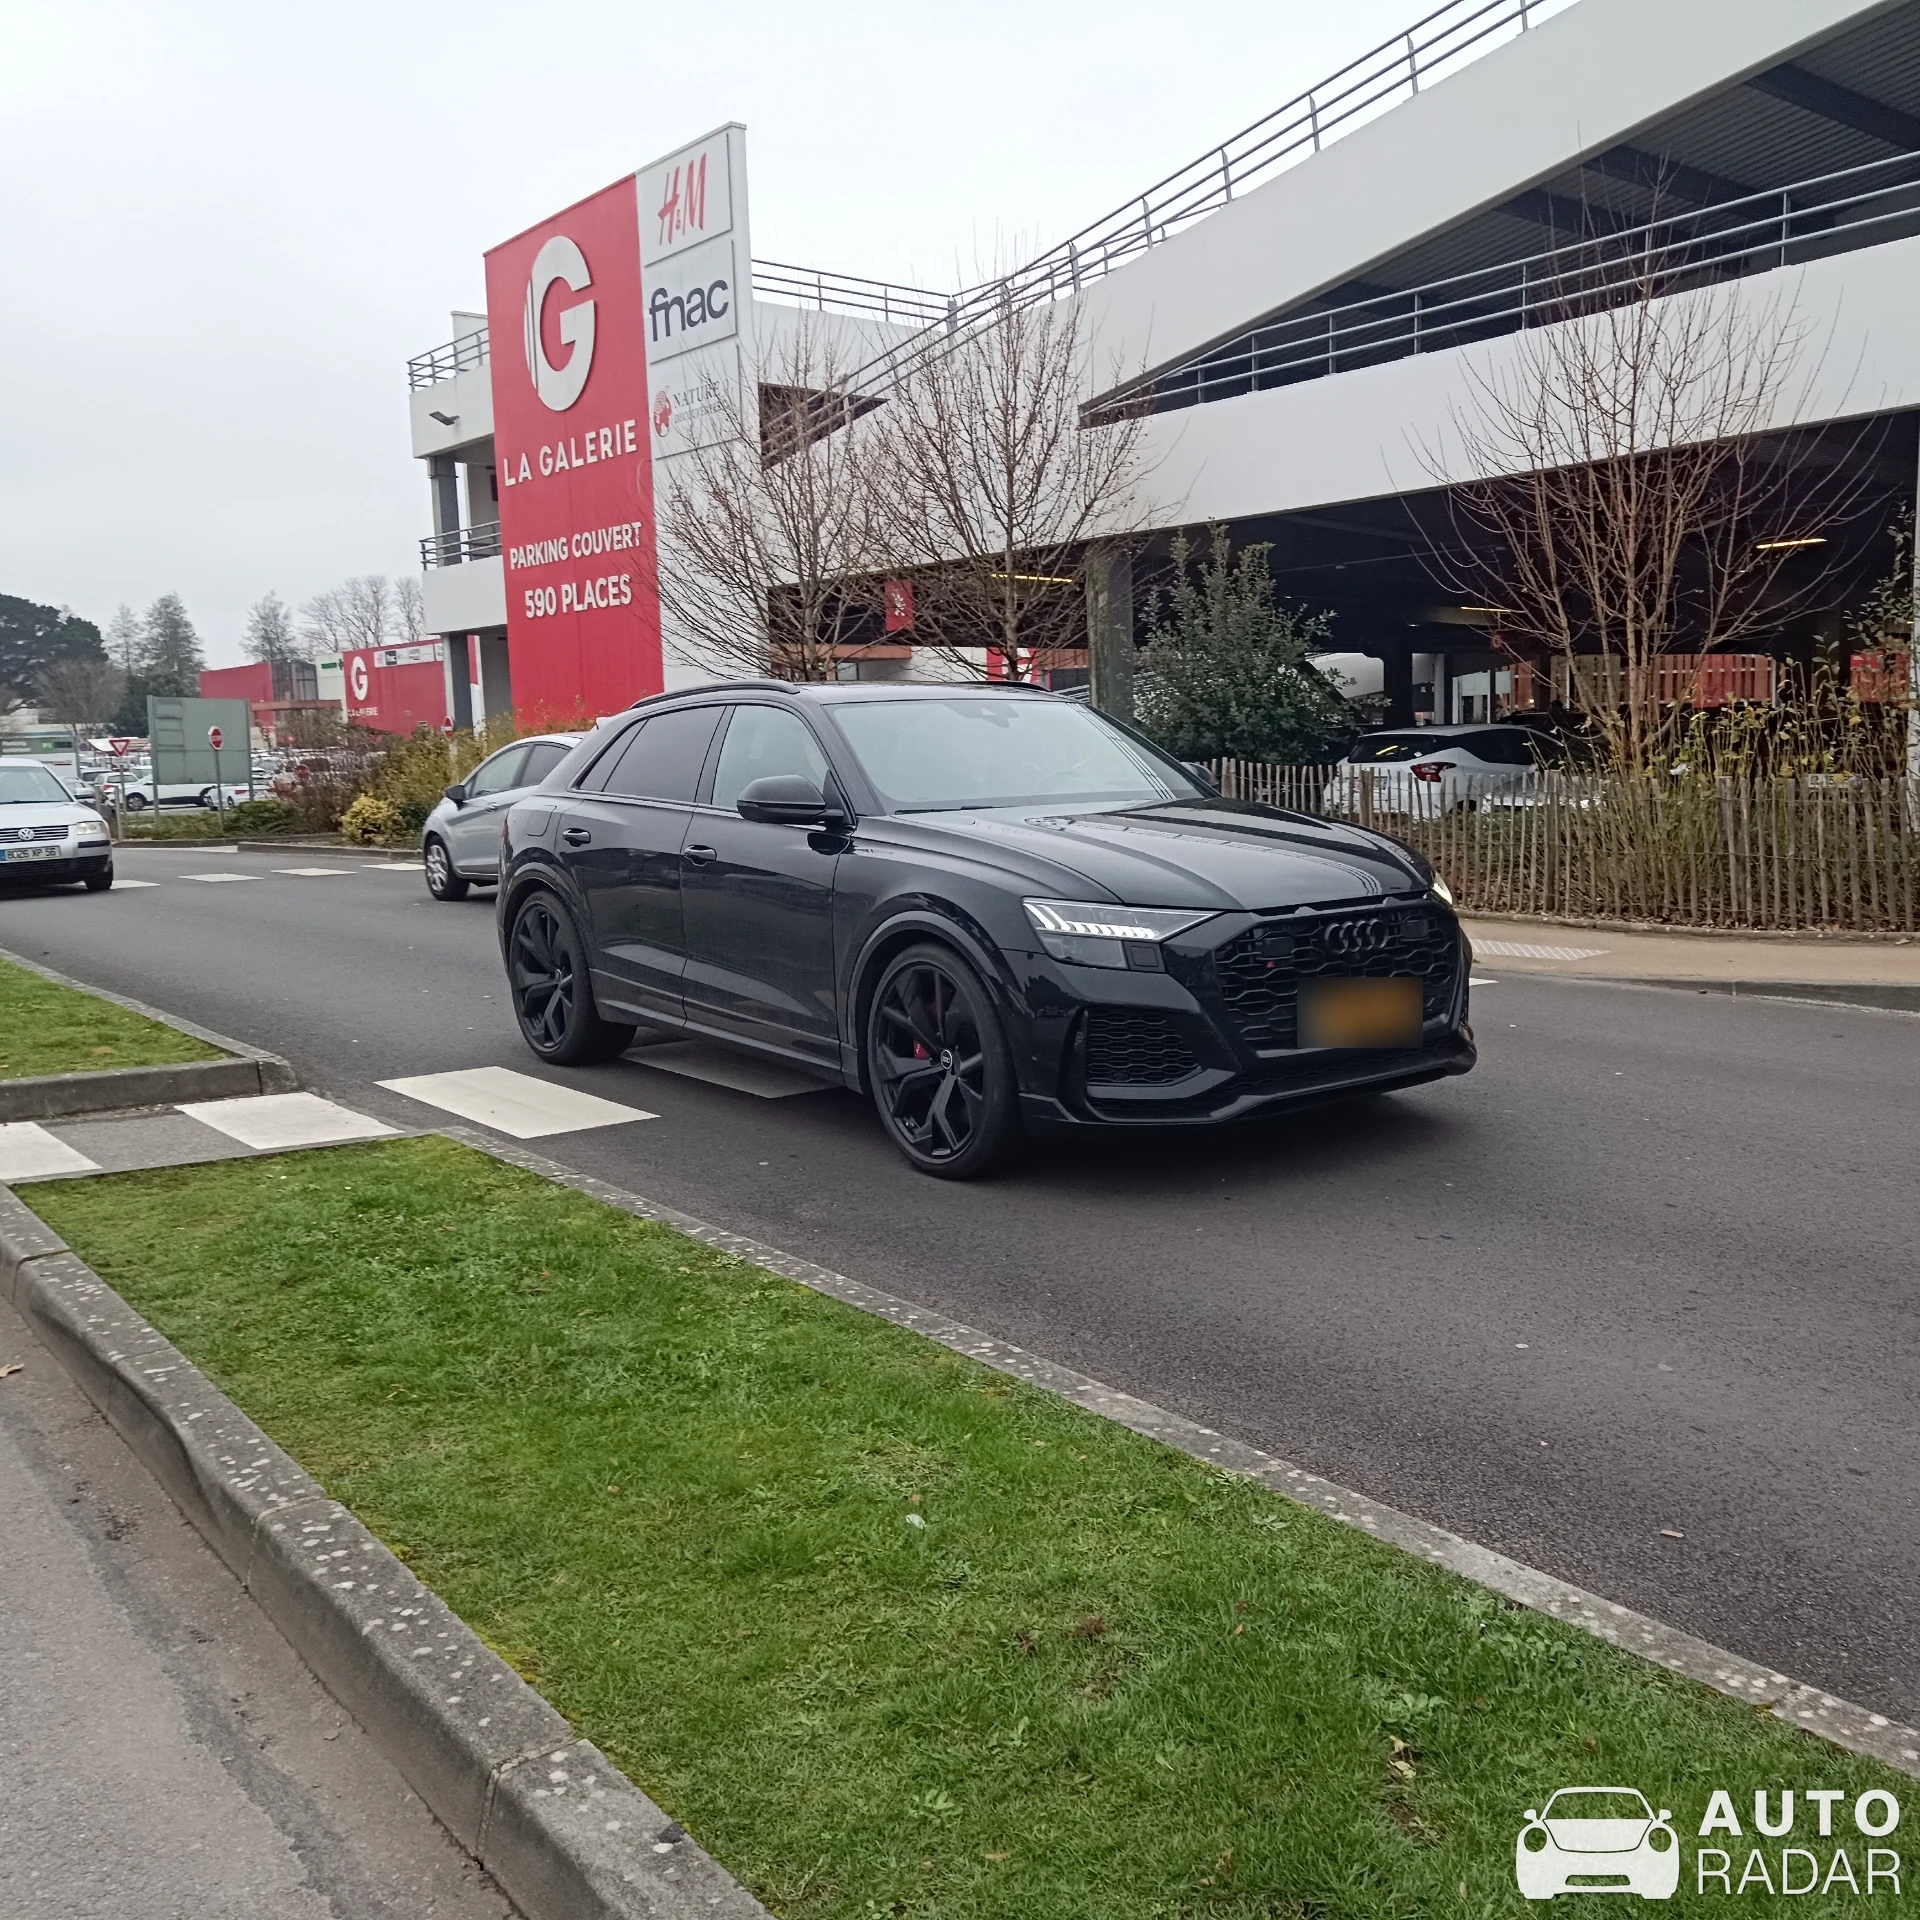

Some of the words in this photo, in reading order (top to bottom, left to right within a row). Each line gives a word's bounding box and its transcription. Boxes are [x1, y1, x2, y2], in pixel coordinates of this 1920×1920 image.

[658, 152, 706, 246] H&M
[649, 279, 729, 342] fnac
[503, 452, 532, 487] LA
[539, 419, 637, 477] GALERIE
[510, 536, 569, 570] PARKING
[572, 522, 642, 558] COUVERT
[524, 586, 556, 619] 590
[561, 573, 632, 613] PLACES
